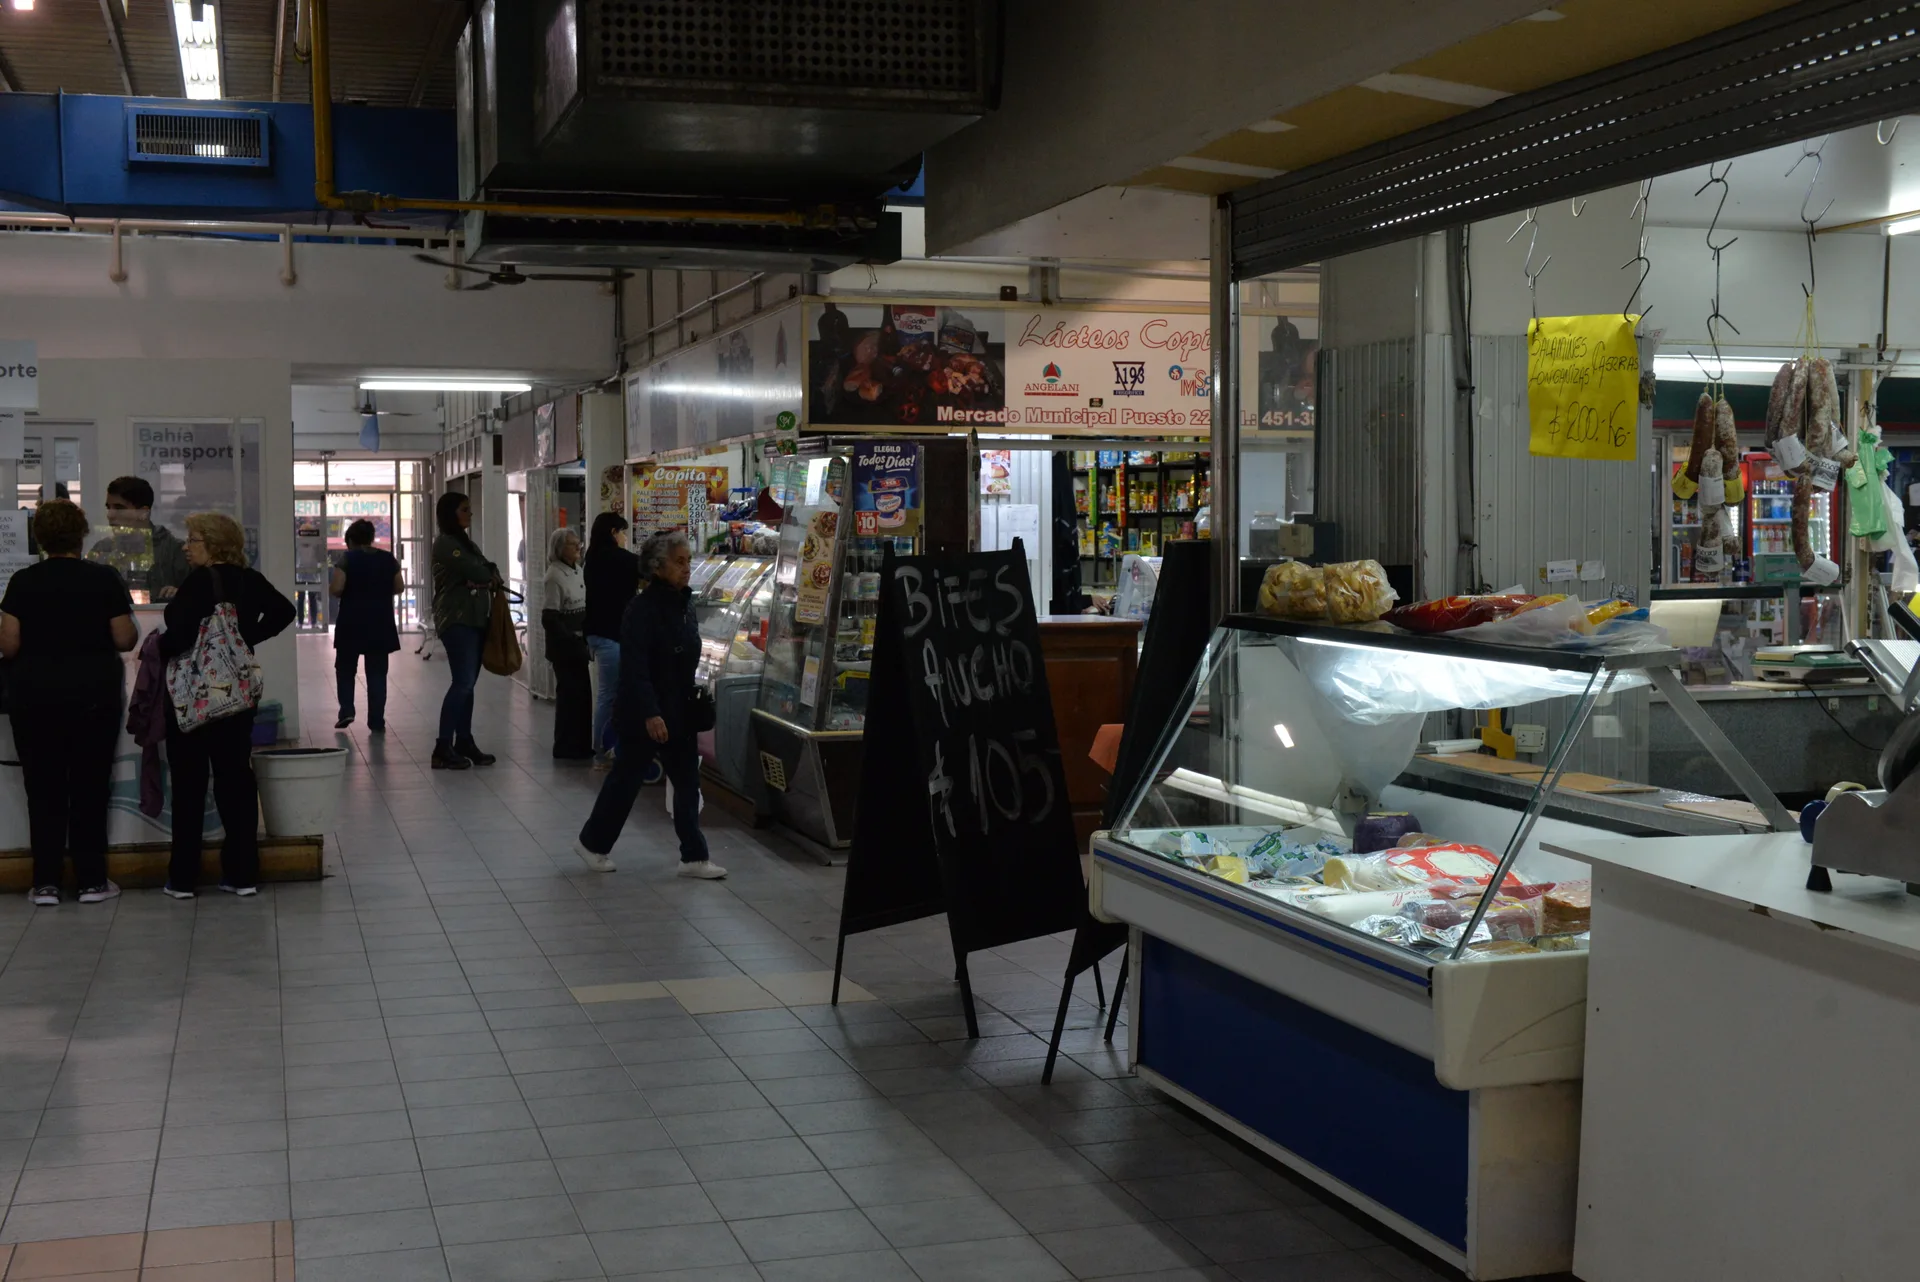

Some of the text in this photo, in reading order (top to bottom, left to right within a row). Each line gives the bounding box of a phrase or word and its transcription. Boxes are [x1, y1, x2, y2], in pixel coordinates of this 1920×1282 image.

[1018, 314, 1129, 349] Lácteos
[1024, 383, 1080, 391] ANGELANI
[937, 406, 1020, 424] Mercado
[1025, 407, 1117, 428] Municipal
[1121, 408, 1187, 426] Puesto
[1261, 410, 1314, 426] 451-3
[139, 427, 194, 442] Bahía
[858, 453, 915, 469] Todos Días!
[653, 467, 706, 484] Copita
[343, 501, 387, 514] CAMPO
[922, 638, 1034, 728] ANCHO
